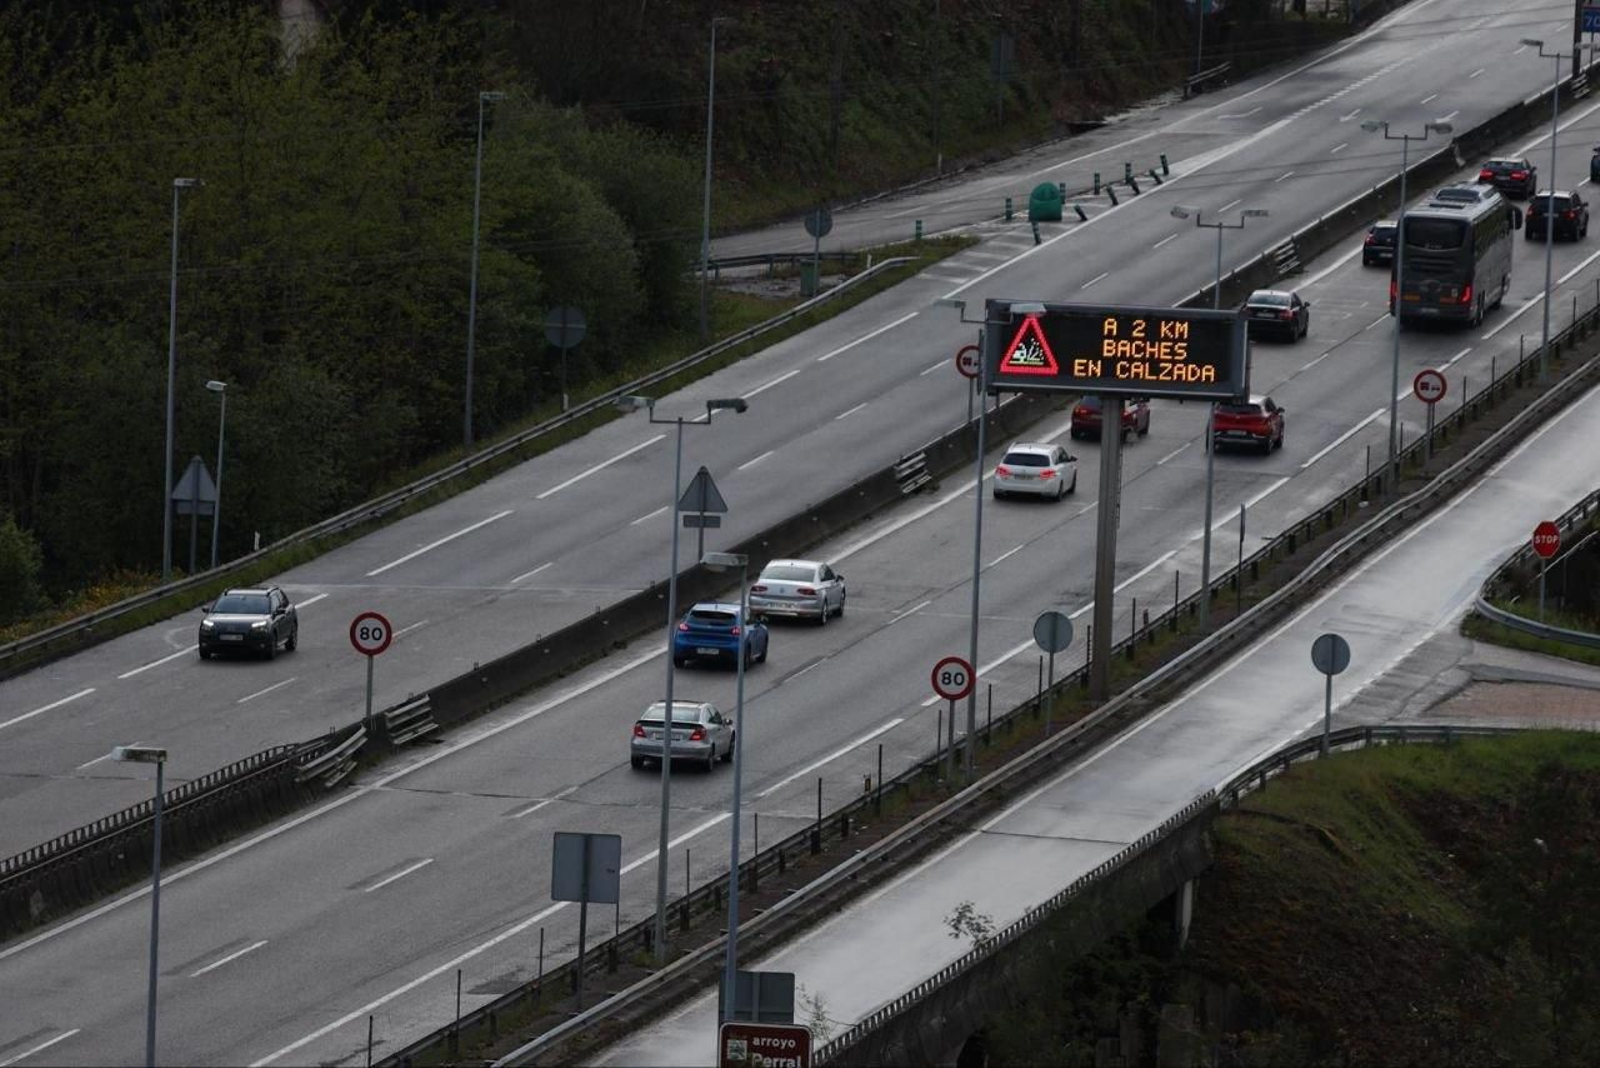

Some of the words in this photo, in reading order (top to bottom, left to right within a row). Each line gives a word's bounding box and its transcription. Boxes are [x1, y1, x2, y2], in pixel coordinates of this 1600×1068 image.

[1104, 318, 1117, 336] A
[1132, 319, 1146, 338] 2
[1160, 320, 1189, 339] KM
[1102, 339, 1188, 360] BACHES
[1073, 358, 1102, 378] EN
[1116, 360, 1215, 382] CALZADA
[1534, 534, 1559, 545] STOP
[360, 626, 383, 641] 80
[941, 671, 965, 686] 80
[752, 1037, 797, 1050] arroyo
[751, 1052, 802, 1068] Perral
